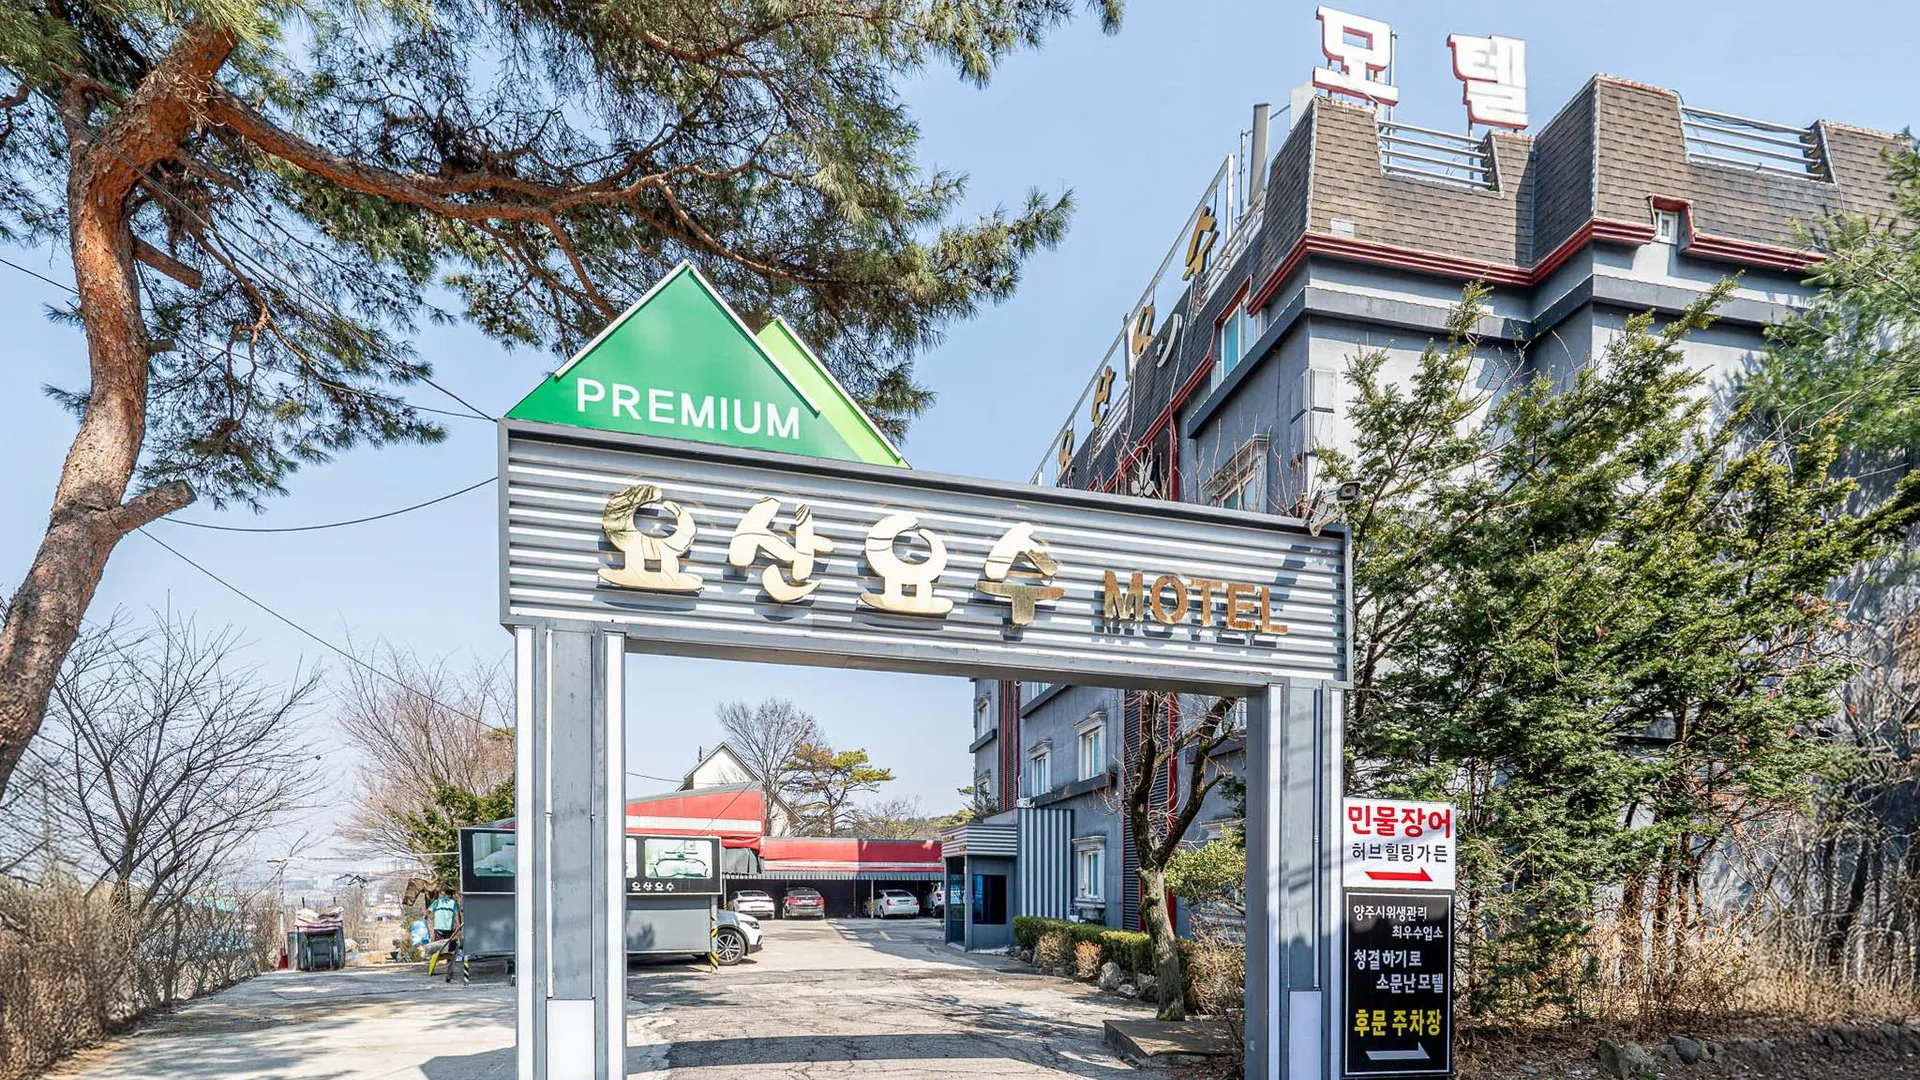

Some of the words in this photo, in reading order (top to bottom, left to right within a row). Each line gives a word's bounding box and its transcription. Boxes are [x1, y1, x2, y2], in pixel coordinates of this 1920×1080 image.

[576, 377, 800, 440] PREMIUM
[597, 484, 1066, 627] 요산요수
[1104, 569, 1288, 634] MOTEL
[1348, 805, 1451, 839] 민물장어
[631, 881, 675, 892] 요산요수
[1354, 1008, 1387, 1037] 후문
[1391, 1008, 1442, 1037] 주차장
